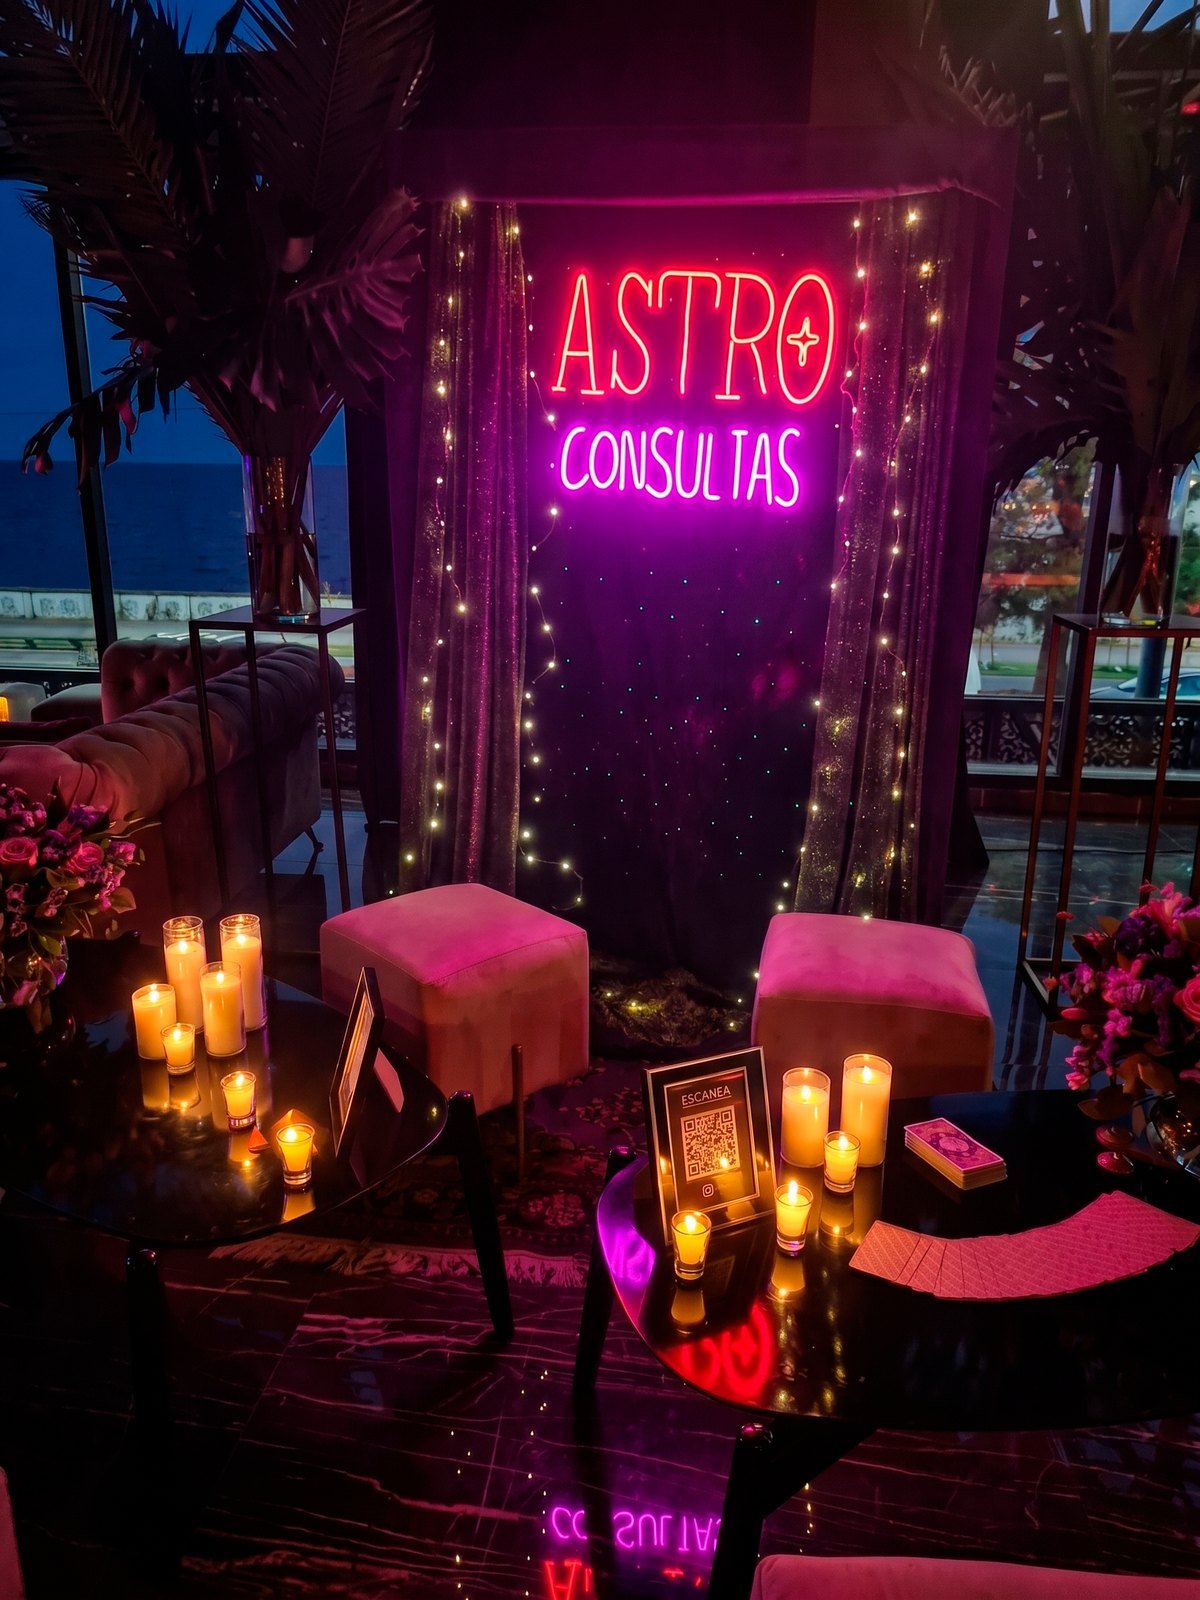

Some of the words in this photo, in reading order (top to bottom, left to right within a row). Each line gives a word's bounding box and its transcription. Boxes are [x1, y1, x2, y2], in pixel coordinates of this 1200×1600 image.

[551, 270, 834, 405] ASTRO
[560, 426, 801, 508] CONSULTAS
[681, 1085, 732, 1106] ESCANEA
